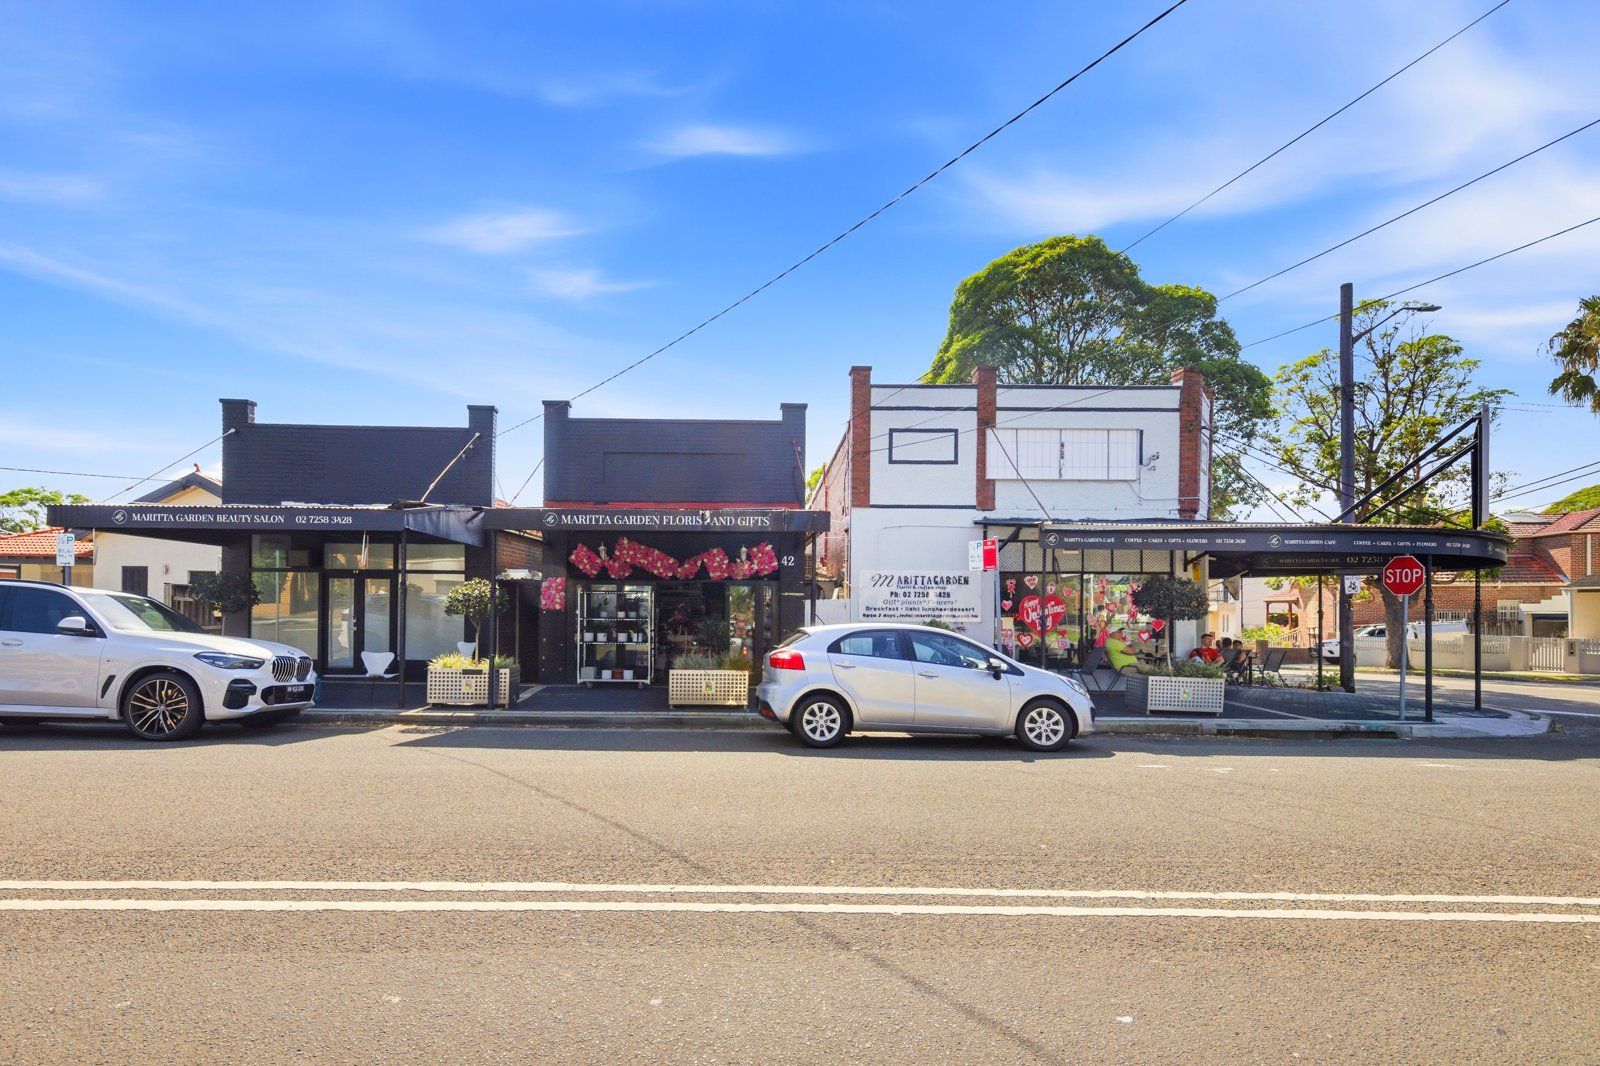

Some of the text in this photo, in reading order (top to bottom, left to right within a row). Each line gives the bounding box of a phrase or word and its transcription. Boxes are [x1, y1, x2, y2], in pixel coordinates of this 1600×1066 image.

[132, 513, 353, 524] MARITTA GARDEN BEAUTY SALON 02 7258 3428
[561, 515, 770, 526] MARITTA GARDEN FLORIS AND GIFTS
[781, 555, 795, 566] 42
[1346, 556, 1359, 564] 02
[1386, 568, 1422, 584] STOP
